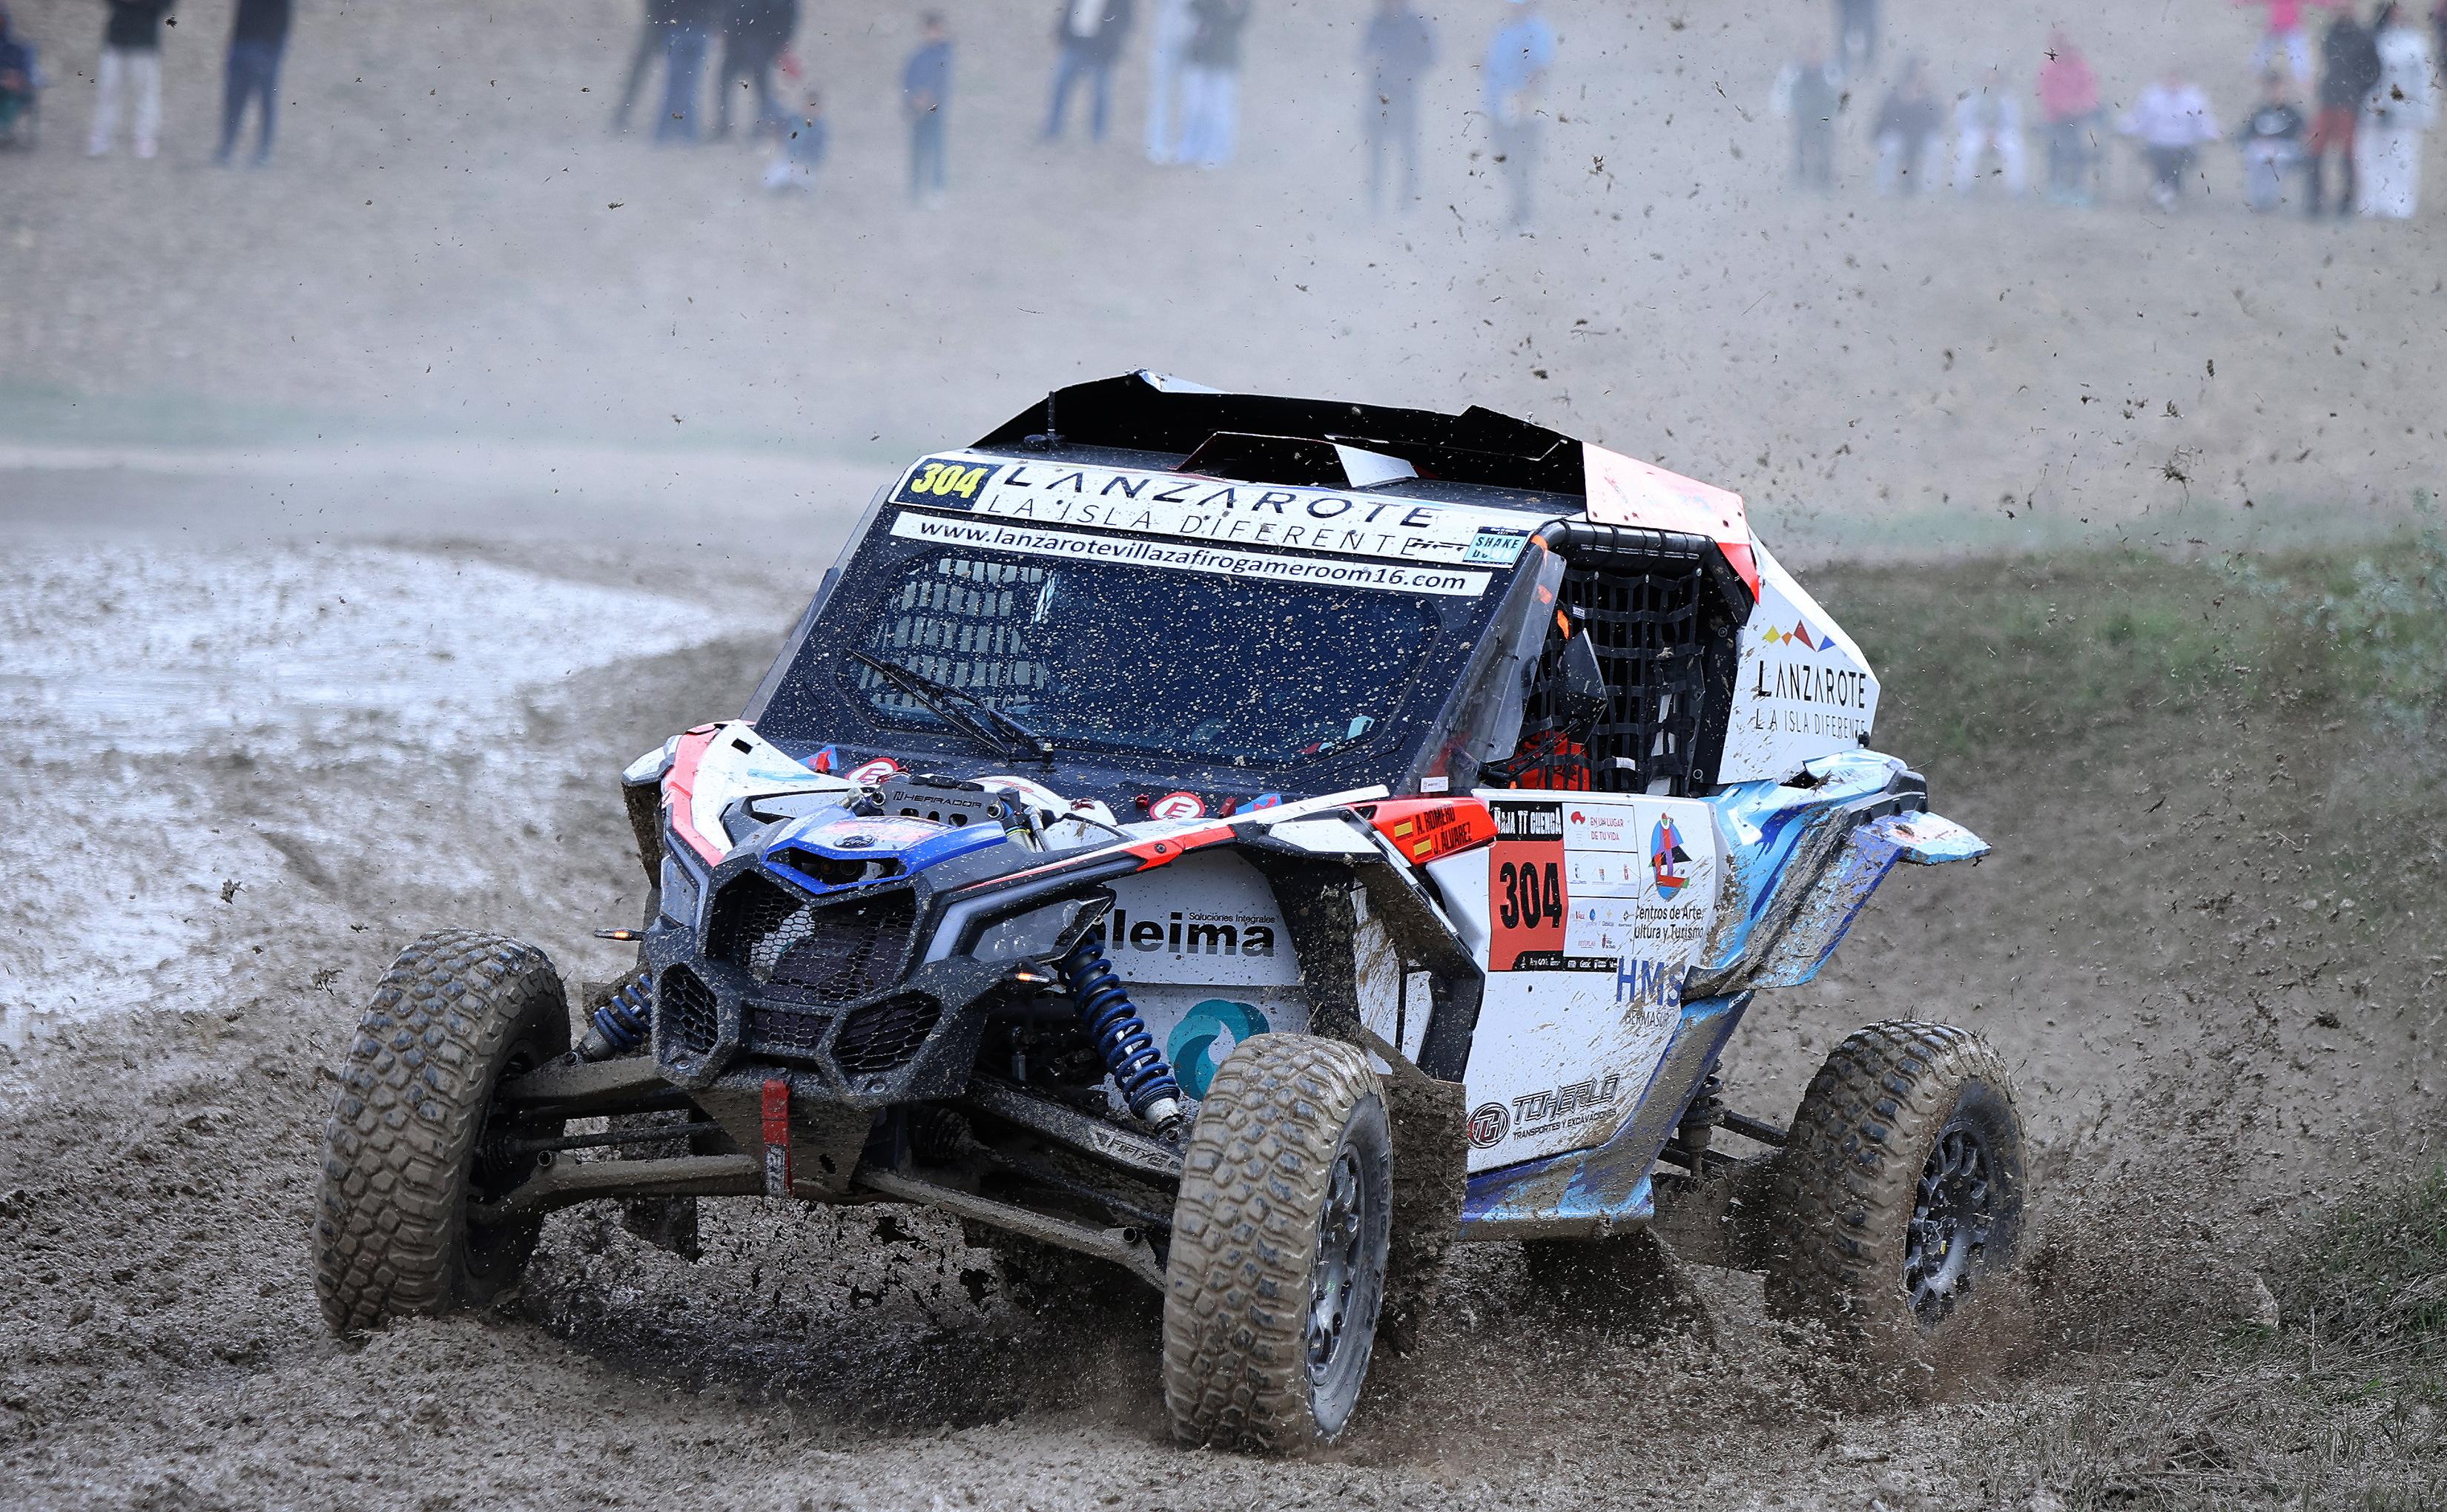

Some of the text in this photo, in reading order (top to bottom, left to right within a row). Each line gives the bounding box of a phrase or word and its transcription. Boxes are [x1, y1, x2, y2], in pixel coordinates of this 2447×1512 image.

[911, 463, 989, 499] 304
[1003, 466, 1444, 528] LANZAROTE
[987, 494, 1420, 556] LA ISLA DIFERENTE
[920, 521, 1466, 590] www.lanzarotevillazafirogameroom16.com
[1476, 536, 1520, 549] SHAKE
[1757, 660, 1866, 709] LANZAROTE
[1755, 708, 1778, 731] LA
[1784, 710, 1810, 734] ISLA
[904, 794, 983, 809] HERRADOR
[1517, 810, 1528, 835] TT
[1530, 807, 1562, 835] CUENCA
[1606, 817, 1624, 828] LUGAR
[1591, 831, 1619, 841] DE TU VIDA
[1499, 861, 1562, 930] 304
[1189, 912, 1275, 925] Soluciones Integrales
[1669, 904, 1680, 920] de
[1634, 923, 1704, 944] ultura y Turismo
[1617, 957, 1685, 1007] HMS
[1513, 1123, 1561, 1141] TRANSPORTES
